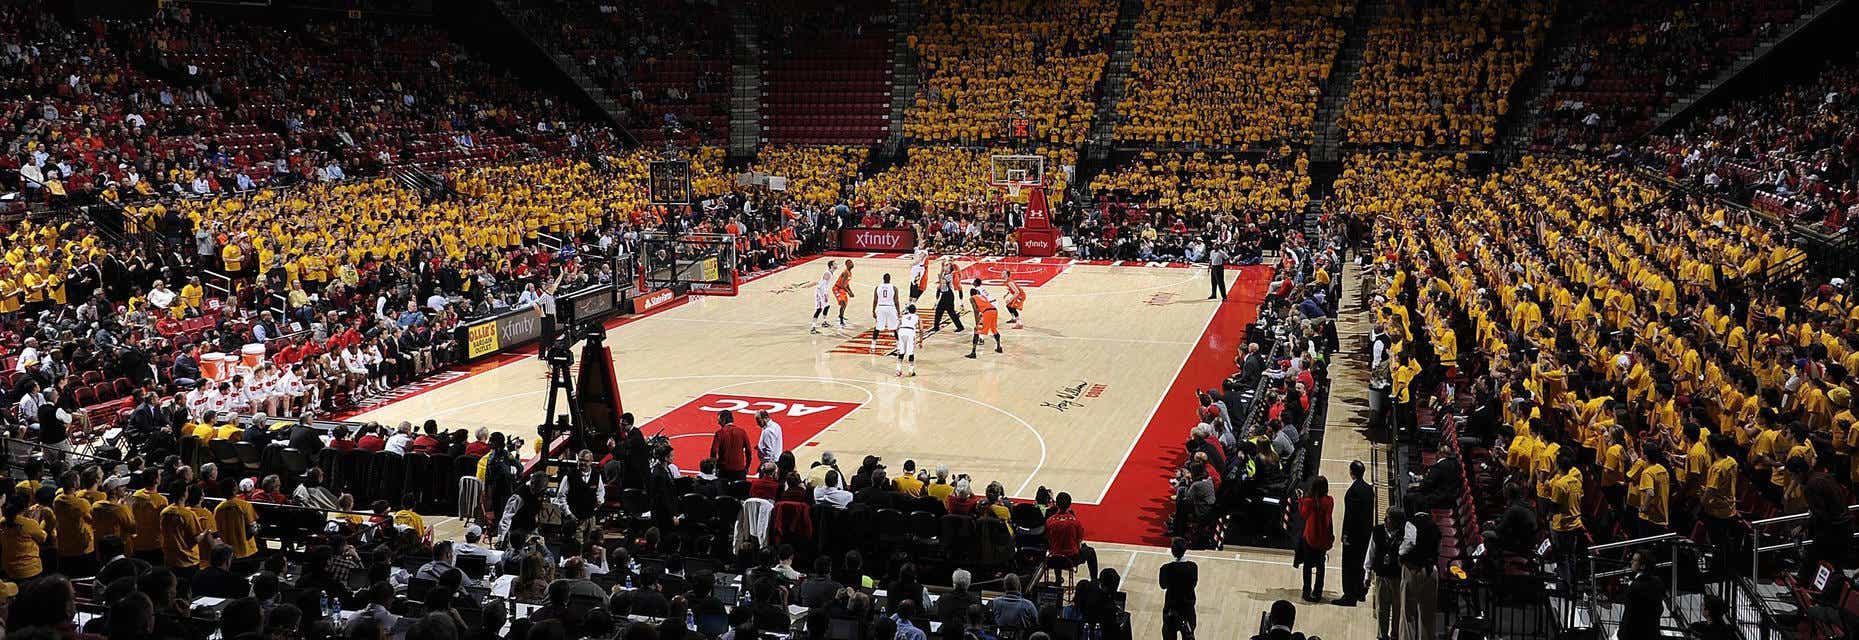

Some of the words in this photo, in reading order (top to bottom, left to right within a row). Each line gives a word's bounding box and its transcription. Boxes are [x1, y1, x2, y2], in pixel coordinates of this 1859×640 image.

[856, 232, 900, 248] xfinity
[470, 324, 496, 343] OLLIE'S
[502, 316, 534, 341] xfinity
[475, 343, 491, 354] OUTLET
[699, 399, 838, 417] ACC
